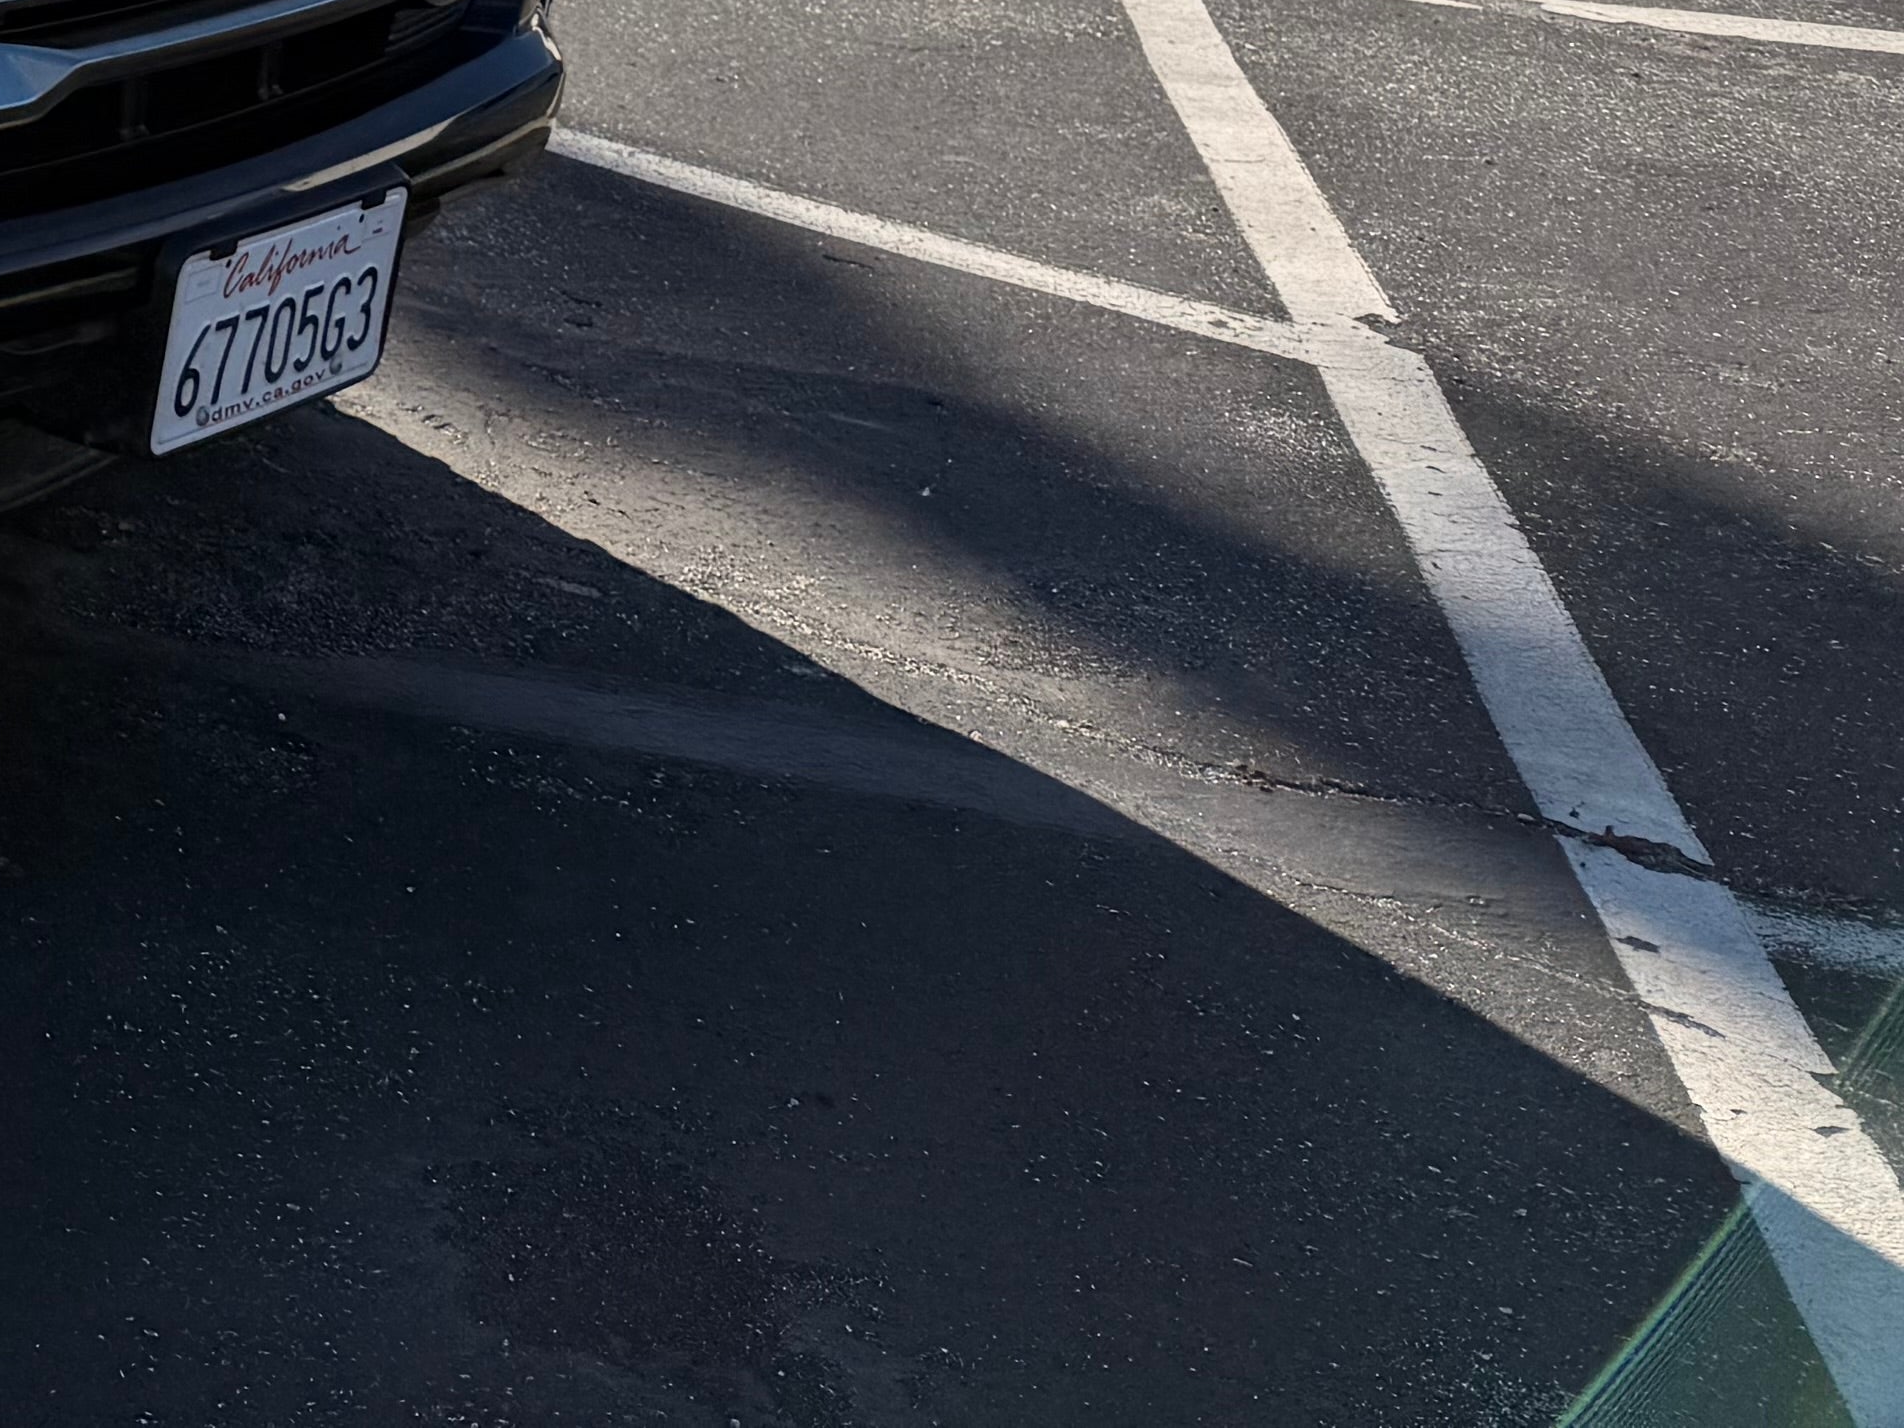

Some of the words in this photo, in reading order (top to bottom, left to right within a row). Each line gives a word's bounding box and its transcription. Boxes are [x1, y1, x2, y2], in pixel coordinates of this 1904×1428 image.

[222, 230, 362, 299] California
[173, 266, 379, 418] 67705G3
[211, 368, 327, 423] dmv.ca.gov
